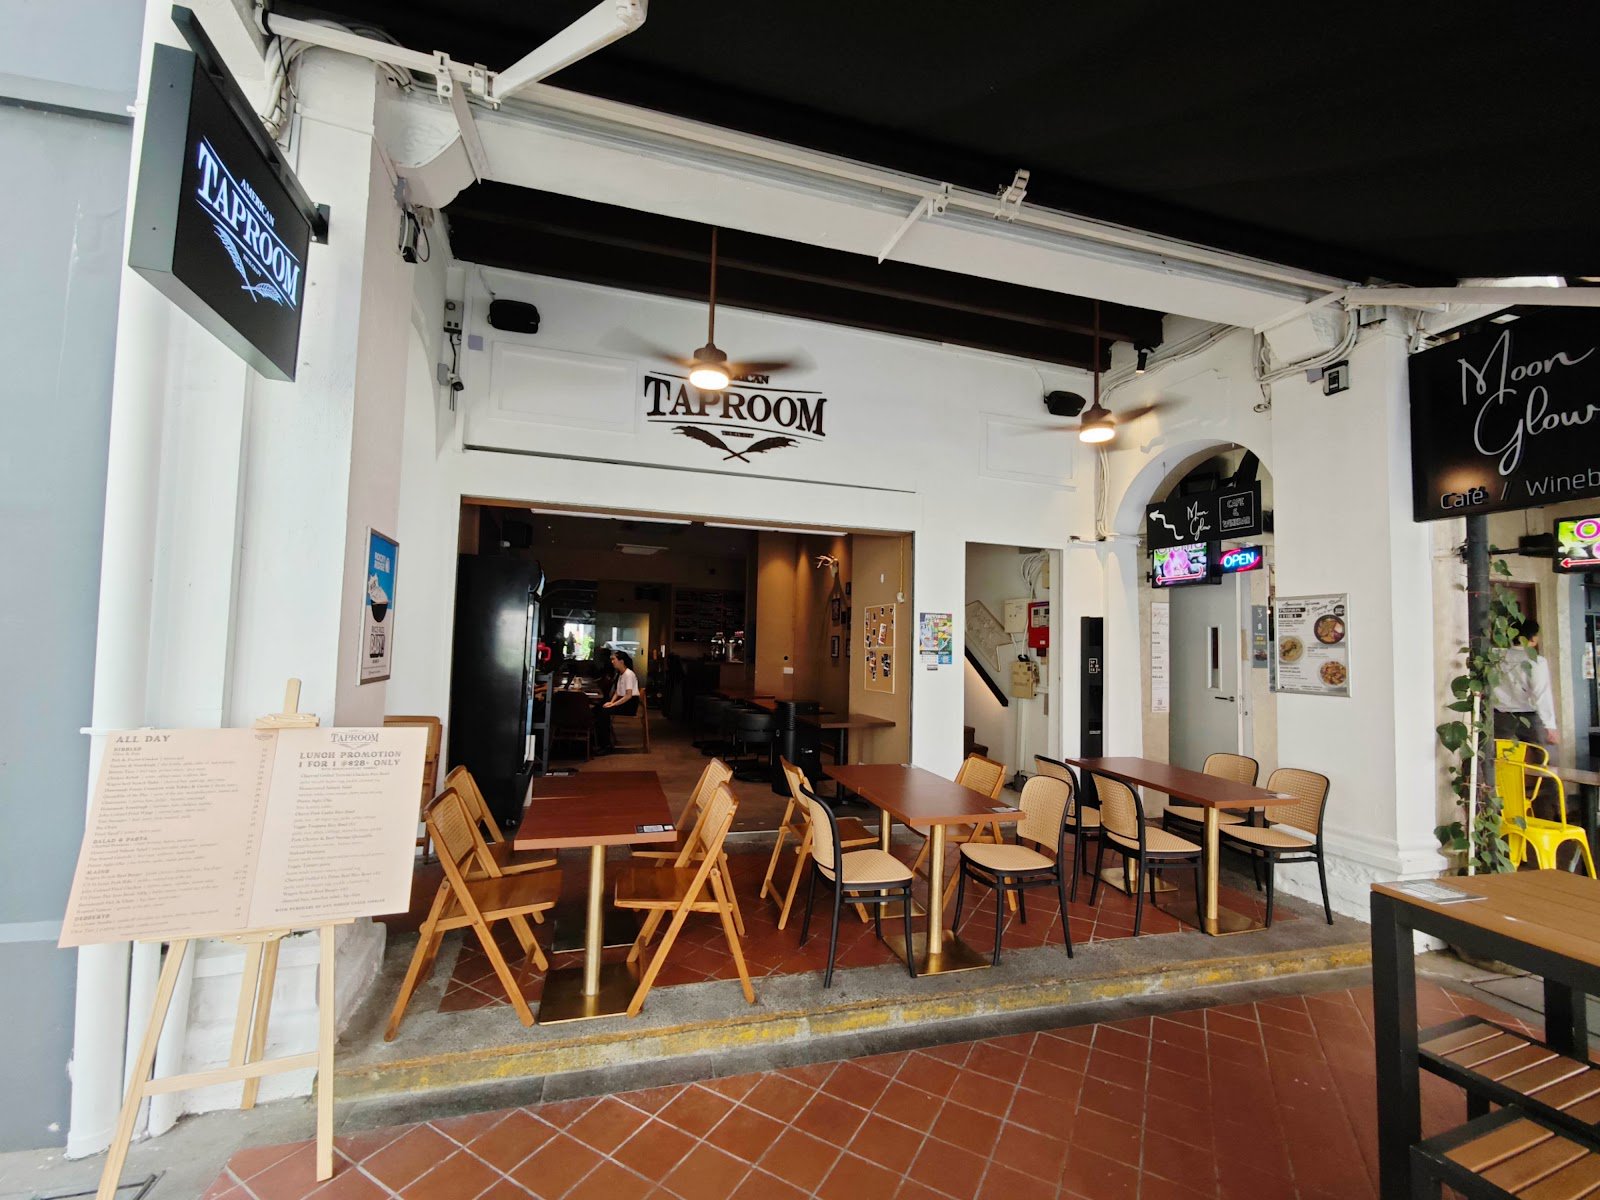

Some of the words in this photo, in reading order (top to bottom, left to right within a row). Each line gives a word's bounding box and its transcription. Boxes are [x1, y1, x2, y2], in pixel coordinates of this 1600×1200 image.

[240, 178, 275, 227] AMERICAN
[197, 141, 300, 305] TAPROOM
[1457, 329, 1595, 405] Moon
[644, 375, 827, 437] TAPROOM
[1474, 385, 1600, 476] Glow
[1223, 551, 1254, 568] OPEN
[116, 735, 140, 743] ALL
[145, 734, 171, 743] DAY
[331, 733, 379, 743] TAPROOM
[299, 751, 336, 760] LUNCH
[340, 750, 402, 759] PROMOTION
[307, 760, 328, 768] FOR
